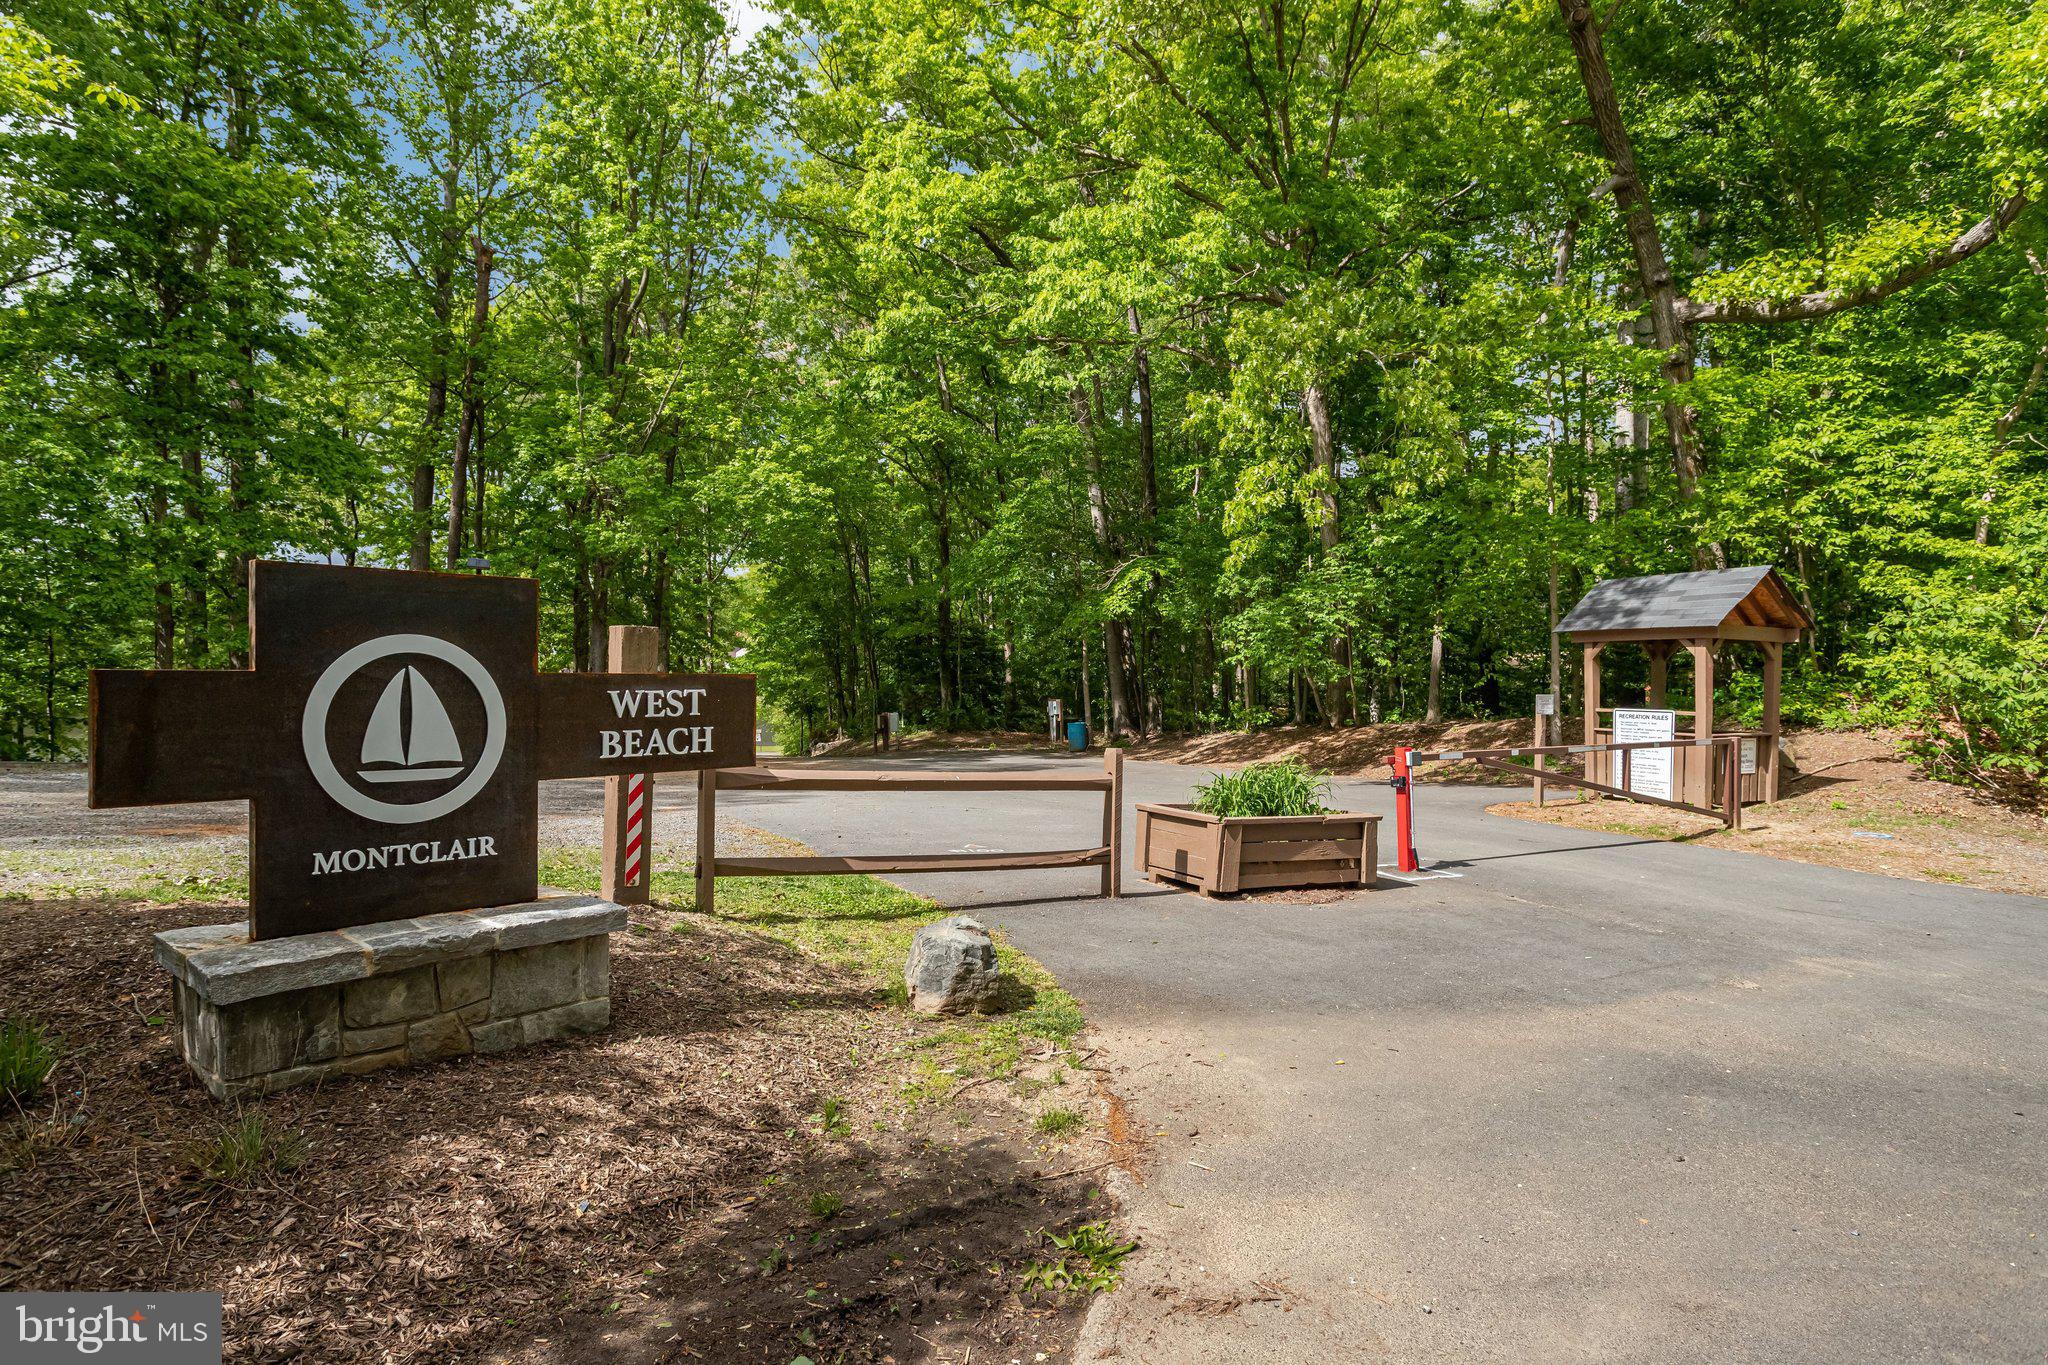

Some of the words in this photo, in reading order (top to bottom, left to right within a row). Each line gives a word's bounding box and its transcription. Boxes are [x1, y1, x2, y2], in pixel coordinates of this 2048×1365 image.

[607, 689, 707, 718] WEST
[600, 726, 714, 759] BEACH
[311, 835, 499, 876] MONTCLAIR
